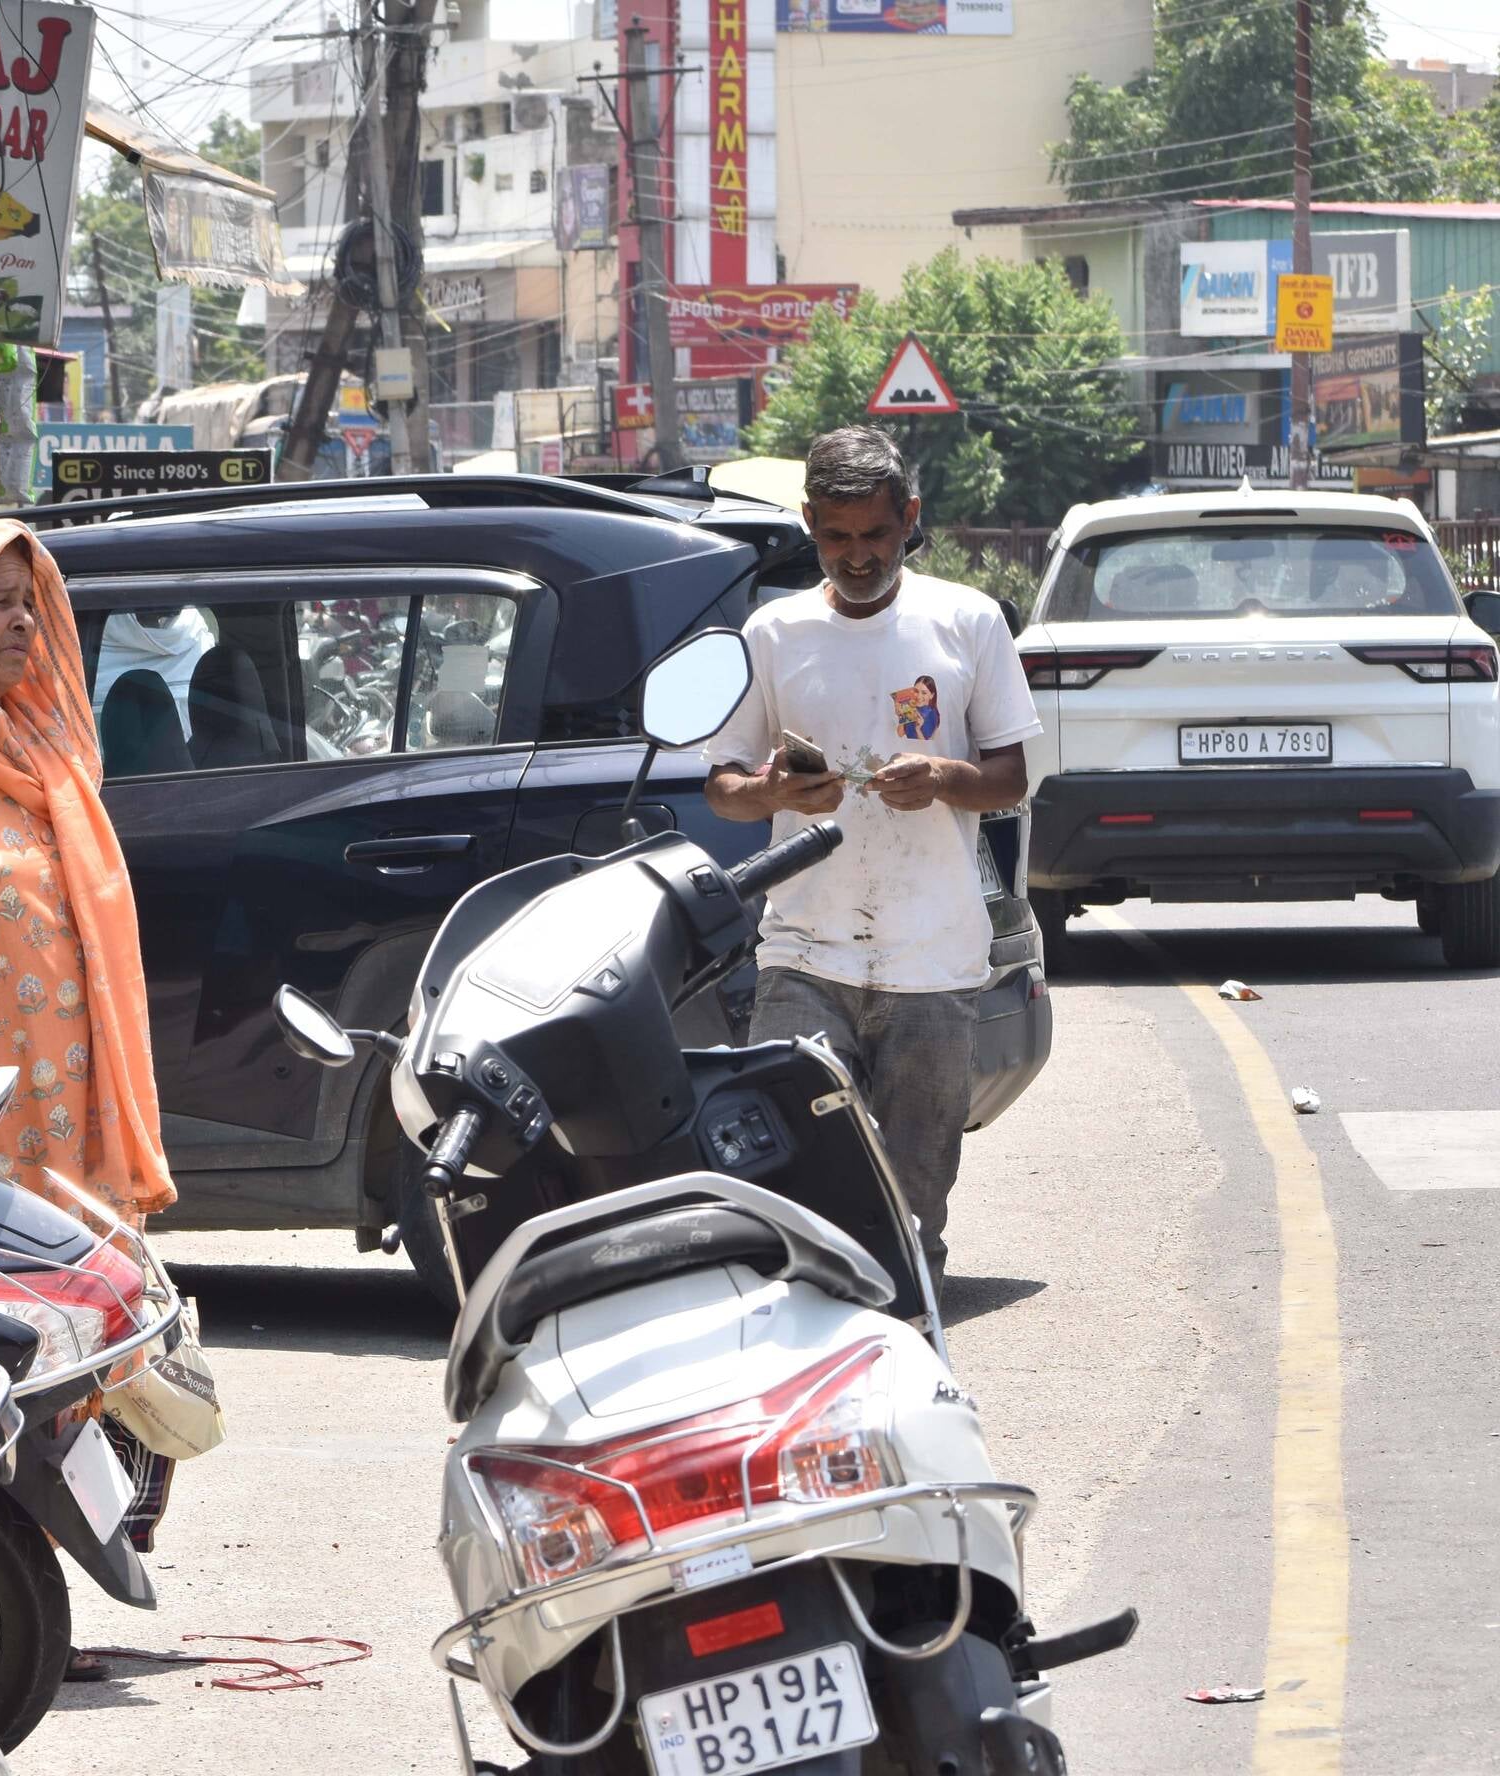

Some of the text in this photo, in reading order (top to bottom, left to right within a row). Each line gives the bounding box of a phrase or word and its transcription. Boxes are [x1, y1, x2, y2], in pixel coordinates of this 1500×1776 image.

[716, 0, 745, 190] HARMA
[0, 252, 37, 270] Pan
[1197, 271, 1254, 299] DAIKIN
[1327, 252, 1379, 299] IFB
[667, 299, 724, 318] APOOR
[760, 297, 847, 319] OPTICS
[1347, 343, 1397, 370] GARMENTS
[1179, 394, 1246, 423] DAIKIN
[113, 465, 156, 480] Since
[159, 464, 209, 480] 1980's
[1167, 445, 1204, 476] AMAR
[1207, 445, 1246, 477] VIDEO
[1198, 732, 1249, 753] HP80
[1259, 732, 1269, 753] A
[1277, 732, 1327, 752] 7890
[160, 1361, 180, 1378] For
[696, 1700, 843, 1775] B3147
